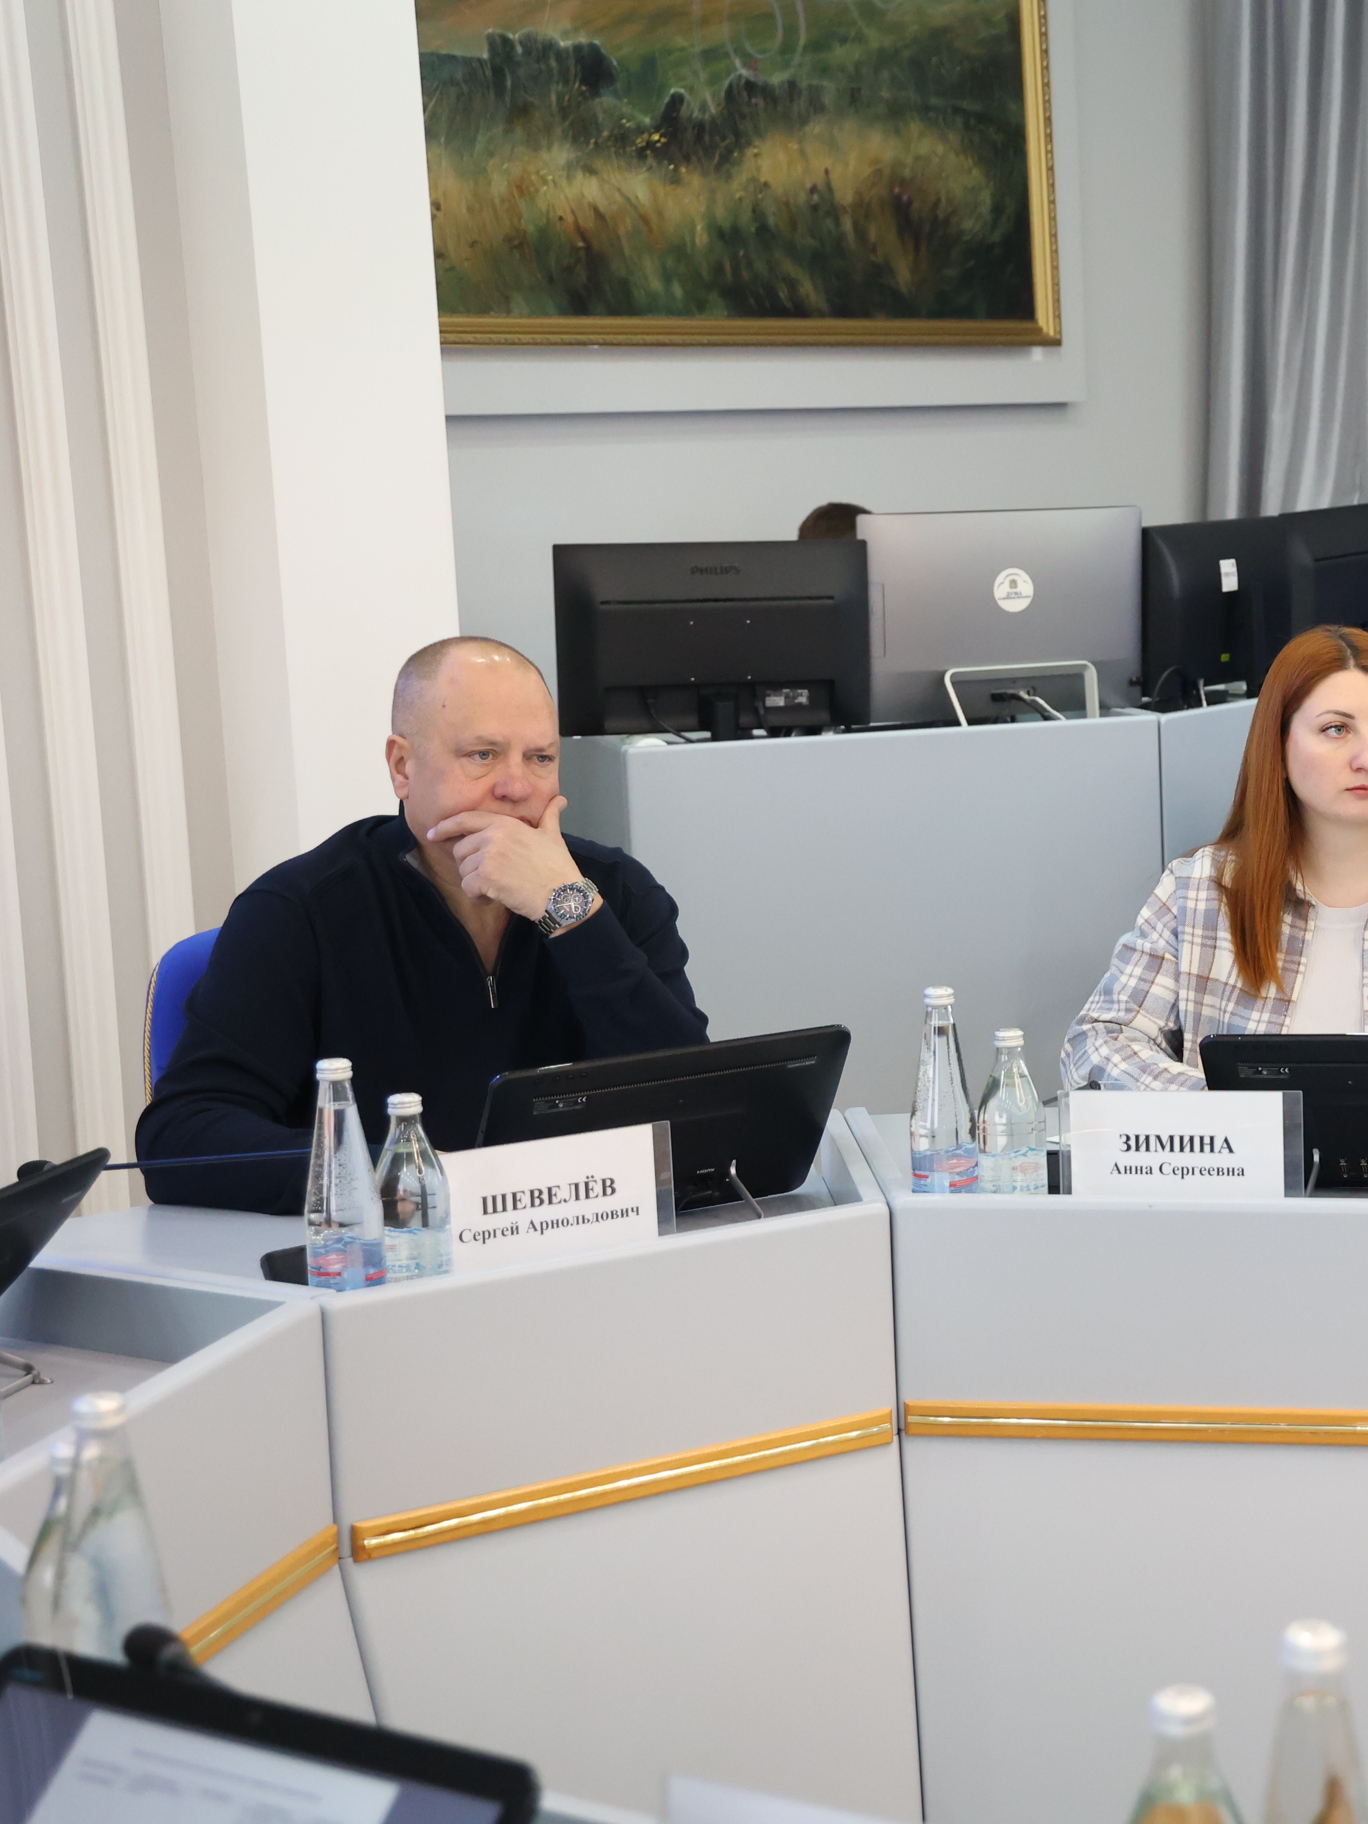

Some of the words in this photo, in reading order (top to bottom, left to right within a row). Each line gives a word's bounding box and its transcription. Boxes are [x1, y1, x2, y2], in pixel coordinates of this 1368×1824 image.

[1118, 1133, 1236, 1154] ЗИМИНА
[1110, 1162, 1154, 1176] Анна
[1158, 1161, 1246, 1180] Сергеевна
[480, 1174, 618, 1216] ШЕВЕЛЁВ
[457, 1221, 521, 1245] Сергей
[525, 1205, 641, 1236] Арнольдович
